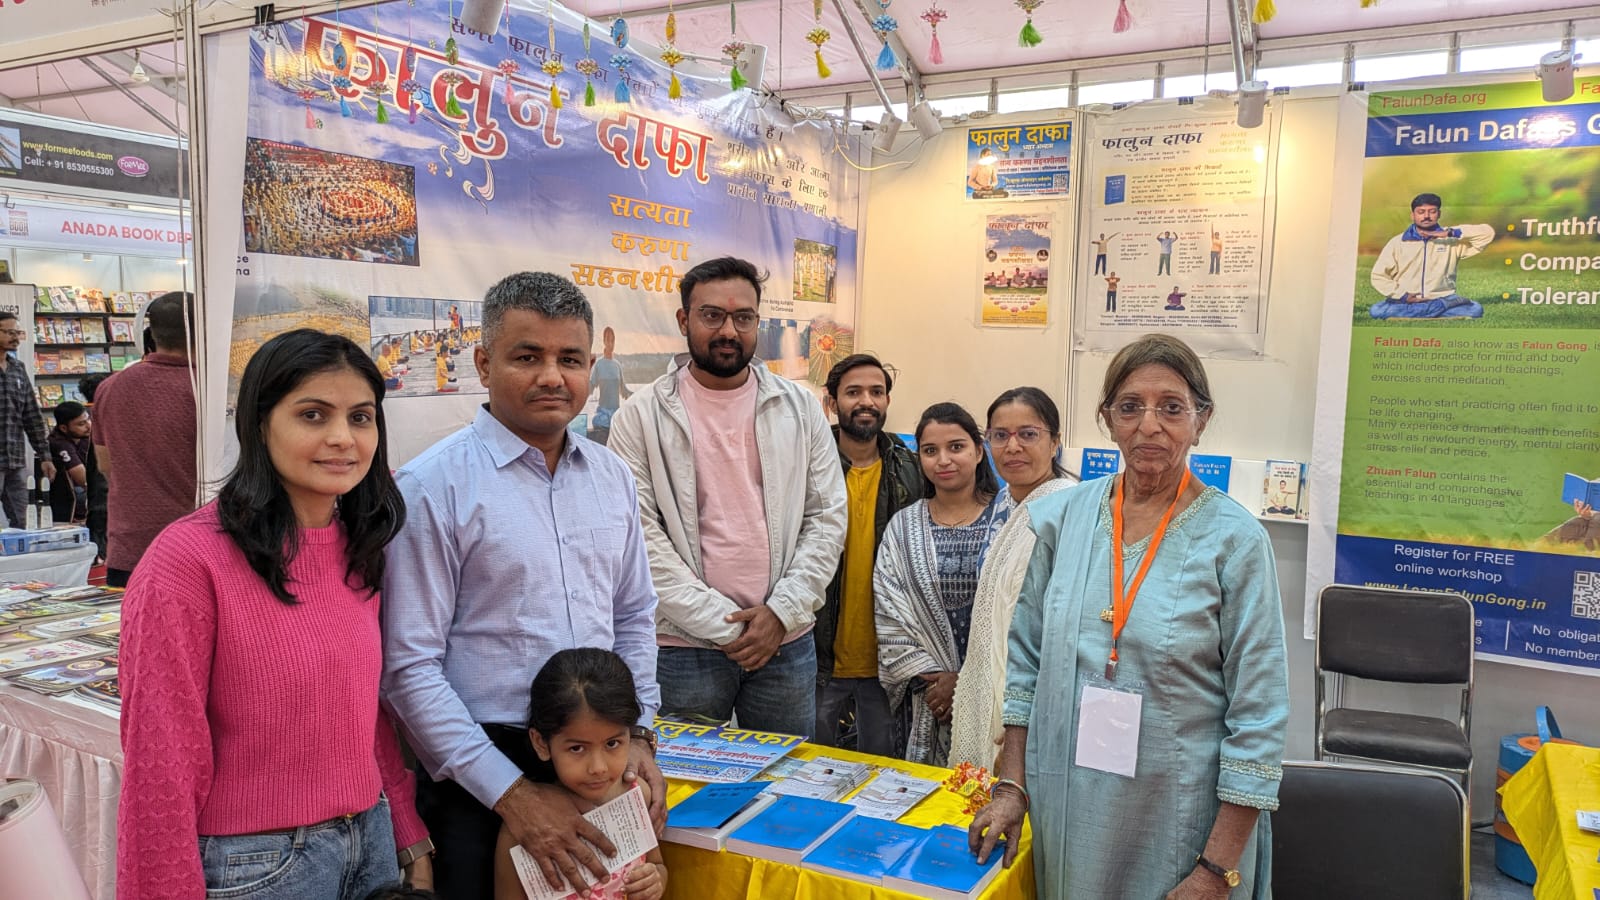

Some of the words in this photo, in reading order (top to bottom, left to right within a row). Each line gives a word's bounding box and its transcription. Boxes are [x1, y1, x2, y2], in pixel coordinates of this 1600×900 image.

[302, 17, 568, 158] फालुन
[597, 111, 713, 184] दाफा
[1382, 92, 1487, 109] FalunDafa.org
[970, 128, 1021, 152] फालुन
[1025, 124, 1070, 144] दाफा
[1102, 135, 1154, 151] फालुन
[1164, 132, 1204, 145] दाफा
[1396, 124, 1469, 146] Falun
[24, 156, 45, 167] Cell:
[54, 160, 65, 169] 91
[66, 163, 114, 176] 8530555300
[608, 193, 693, 228] सत्यता
[61, 220, 118, 238] ANADA
[121, 226, 164, 242] BOOK
[1521, 216, 1600, 237] Truthf
[612, 231, 692, 261] करुणा
[1374, 336, 1409, 348] Falun
[1448, 339, 1470, 349] also
[1473, 340, 1503, 350] know
[1505, 341, 1519, 350] as
[1522, 340, 1553, 350] Falun
[1372, 361, 1402, 371] which
[1405, 362, 1450, 372] includes
[1452, 362, 1502, 374] profound
[1373, 351, 1386, 359] an
[1389, 351, 1428, 360] ancient
[1431, 351, 1474, 362] practice
[1477, 353, 1491, 361] for
[1495, 353, 1523, 362] mind
[1526, 353, 1548, 362] and
[1551, 354, 1580, 365] body
[1371, 374, 1421, 383] exercises
[1424, 375, 1445, 384] and
[1369, 395, 1406, 407] People
[1409, 398, 1432, 407] who
[1434, 399, 1458, 408] start
[1462, 399, 1516, 413] practicing
[1518, 400, 1548, 412] often
[1551, 401, 1573, 413] find
[1576, 403, 1583, 413] it
[1587, 404, 1599, 414] to
[1369, 407, 1382, 417] be
[1385, 407, 1400, 417] life
[1368, 418, 1398, 430] Many
[1400, 421, 1459, 432] experience
[1462, 423, 1511, 434] dramatic
[1513, 425, 1549, 436] health
[1366, 443, 1398, 453] stress
[1400, 444, 1427, 454] relief
[1429, 446, 1450, 456] and
[1367, 432, 1380, 440] as
[1382, 431, 1404, 441] well
[1406, 434, 1419, 442] as
[1421, 434, 1476, 445] newfound
[1523, 438, 1562, 449] mental
[1366, 465, 1402, 477] Zhuan
[1404, 468, 1437, 479] Falun
[1440, 470, 1487, 482] contains
[1489, 472, 1508, 484] the
[1364, 489, 1415, 503] teachings
[1418, 493, 1429, 502] in
[1431, 494, 1445, 504] 40
[1365, 478, 1412, 489] essential
[1414, 480, 1436, 491] and
[1438, 484, 1524, 497] comprehensive
[1394, 544, 1448, 560] Register
[1452, 549, 1471, 562] for
[1474, 551, 1515, 566] FREE
[1395, 563, 1434, 576] online
[1437, 567, 1503, 584] workshop
[1364, 581, 1547, 610] wwwLFlunGong.in
[1532, 624, 1551, 636] No
[1525, 641, 1544, 654] No
[1546, 646, 1600, 662] member
[653, 718, 718, 739] ालुन
[719, 726, 804, 748] दाफा
